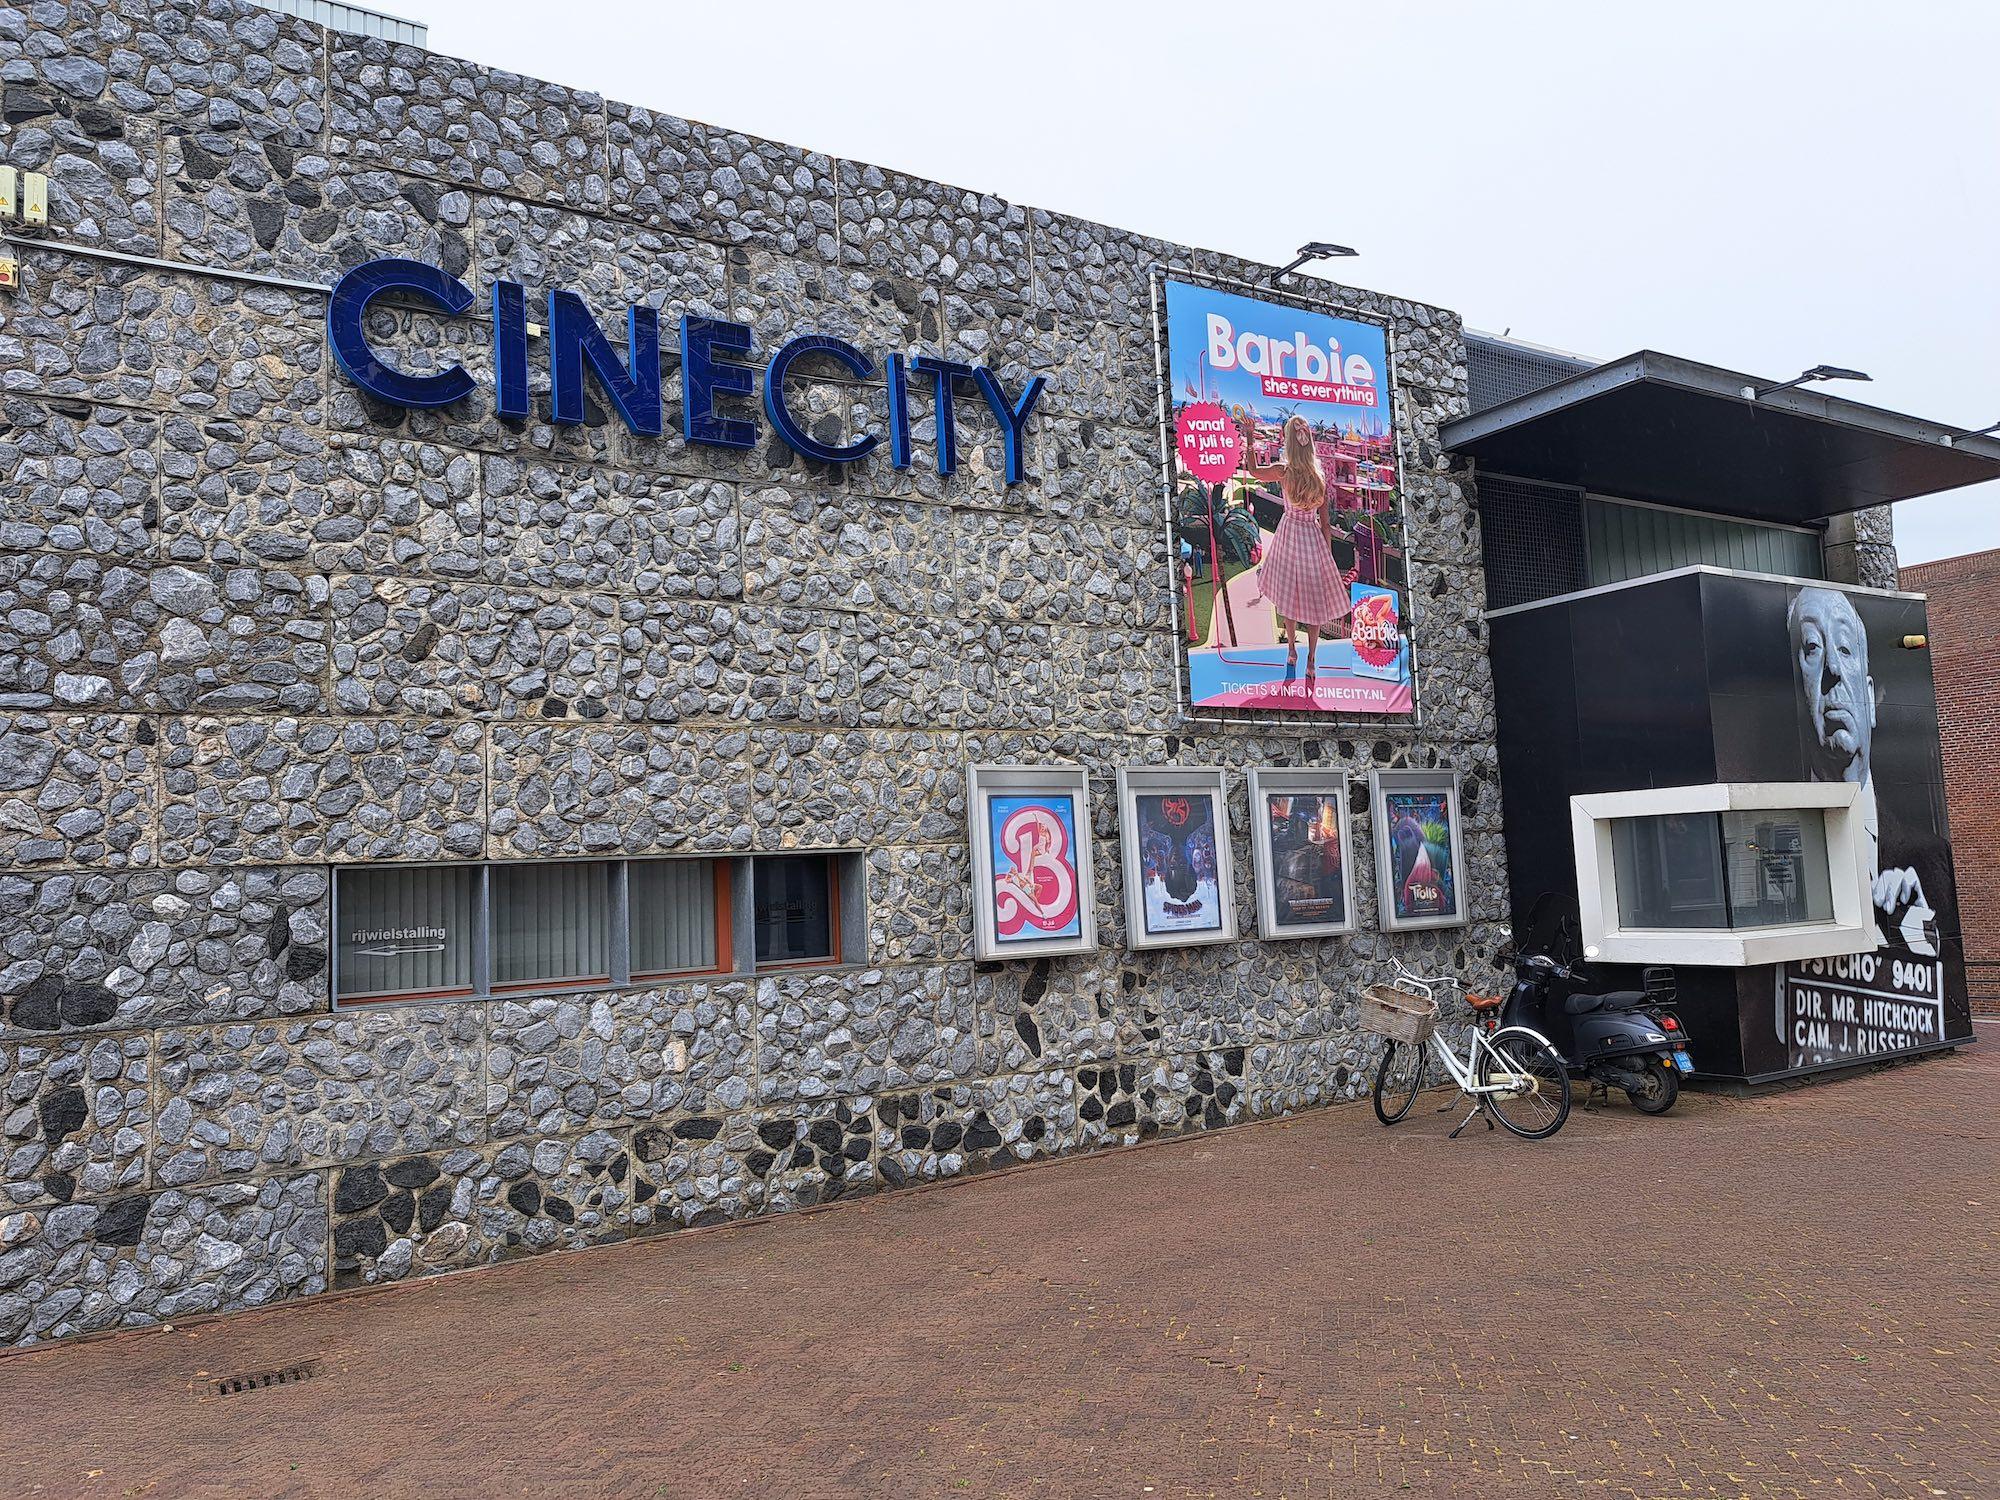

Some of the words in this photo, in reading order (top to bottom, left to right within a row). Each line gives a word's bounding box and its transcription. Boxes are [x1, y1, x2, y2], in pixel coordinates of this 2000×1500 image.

[1207, 313, 1376, 387] Barbie
[328, 258, 1045, 484] CINECITY
[1265, 378, 1298, 396] she's
[1301, 383, 1374, 405] everything
[1187, 418, 1225, 431] vanaf
[1184, 434, 1196, 448] 19
[1199, 434, 1217, 451] juli
[1220, 434, 1234, 448] te
[1198, 451, 1225, 465] zien
[1352, 619, 1398, 641] Barbie
[1221, 681, 1267, 696] TICKETS
[1270, 685, 1278, 696] &
[1280, 685, 1306, 698] INFO
[1315, 686, 1386, 700] CINECITY.NL
[1409, 884, 1437, 901] Trolls
[352, 925, 446, 944] rijwielstalling
[1892, 959, 1932, 993] 9401
[1796, 989, 1826, 1020] DIR.
[1832, 993, 1859, 1024] MR.
[1864, 999, 1933, 1034] HITCHCOCK
[1795, 1020, 1833, 1051] CAM.
[1839, 1025, 1852, 1053] J.
[1857, 1028, 1919, 1056] RUSSE
